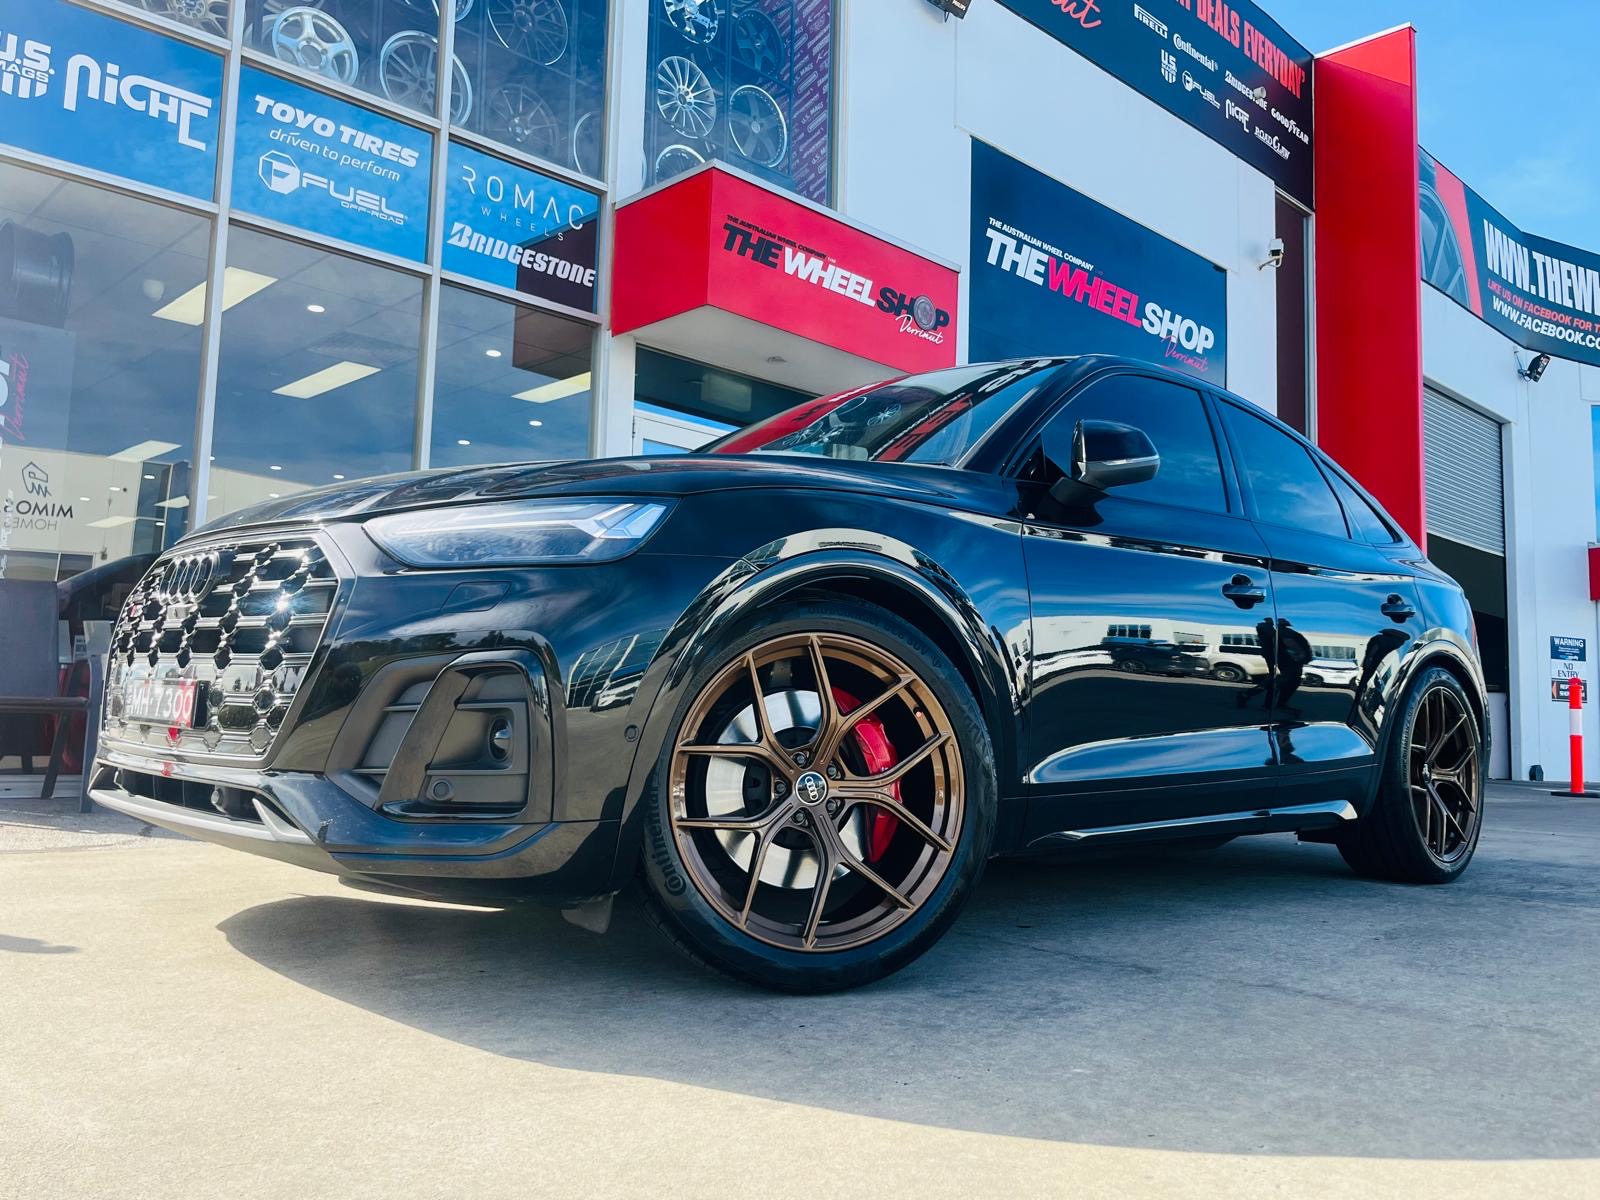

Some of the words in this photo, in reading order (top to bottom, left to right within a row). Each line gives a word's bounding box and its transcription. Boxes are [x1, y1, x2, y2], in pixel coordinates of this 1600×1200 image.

[1134, 3, 1168, 39] PIRELLI
[1173, 33, 1215, 72] Continental
[1224, 69, 1268, 110] BRIDGESONE
[255, 94, 336, 137] TOYO
[339, 124, 420, 168] TIRES
[269, 128, 320, 155] driven
[322, 145, 339, 161] to
[340, 154, 401, 182] perform
[302, 171, 404, 219] FUEL
[340, 201, 404, 226] OFF-ROAD
[461, 165, 584, 231] ROMAC
[480, 207, 564, 242] WHEELS
[989, 217, 1002, 229] THE
[1002, 224, 1042, 247] AUSTRALIAN
[1042, 242, 1063, 257] WHEEL
[1064, 253, 1094, 271] COMPANY
[447, 221, 597, 288] BRIDGESTONE
[723, 223, 784, 269] THE
[784, 246, 876, 307] WHEEL
[876, 287, 950, 332] SHOP
[986, 228, 1049, 286] THE
[1047, 255, 1143, 328] WHEEL
[1142, 302, 1215, 355] SHOP
[1488, 278, 1502, 295] LIKE
[1502, 288, 1511, 302] US
[1512, 295, 1523, 308] ON
[1523, 301, 1573, 326] FACEBOOK
[1573, 317, 1592, 332] FOR
[1553, 637, 1584, 648] WARNING
[1563, 662, 1574, 671] NO
[1557, 669, 1580, 678] ENTRY
